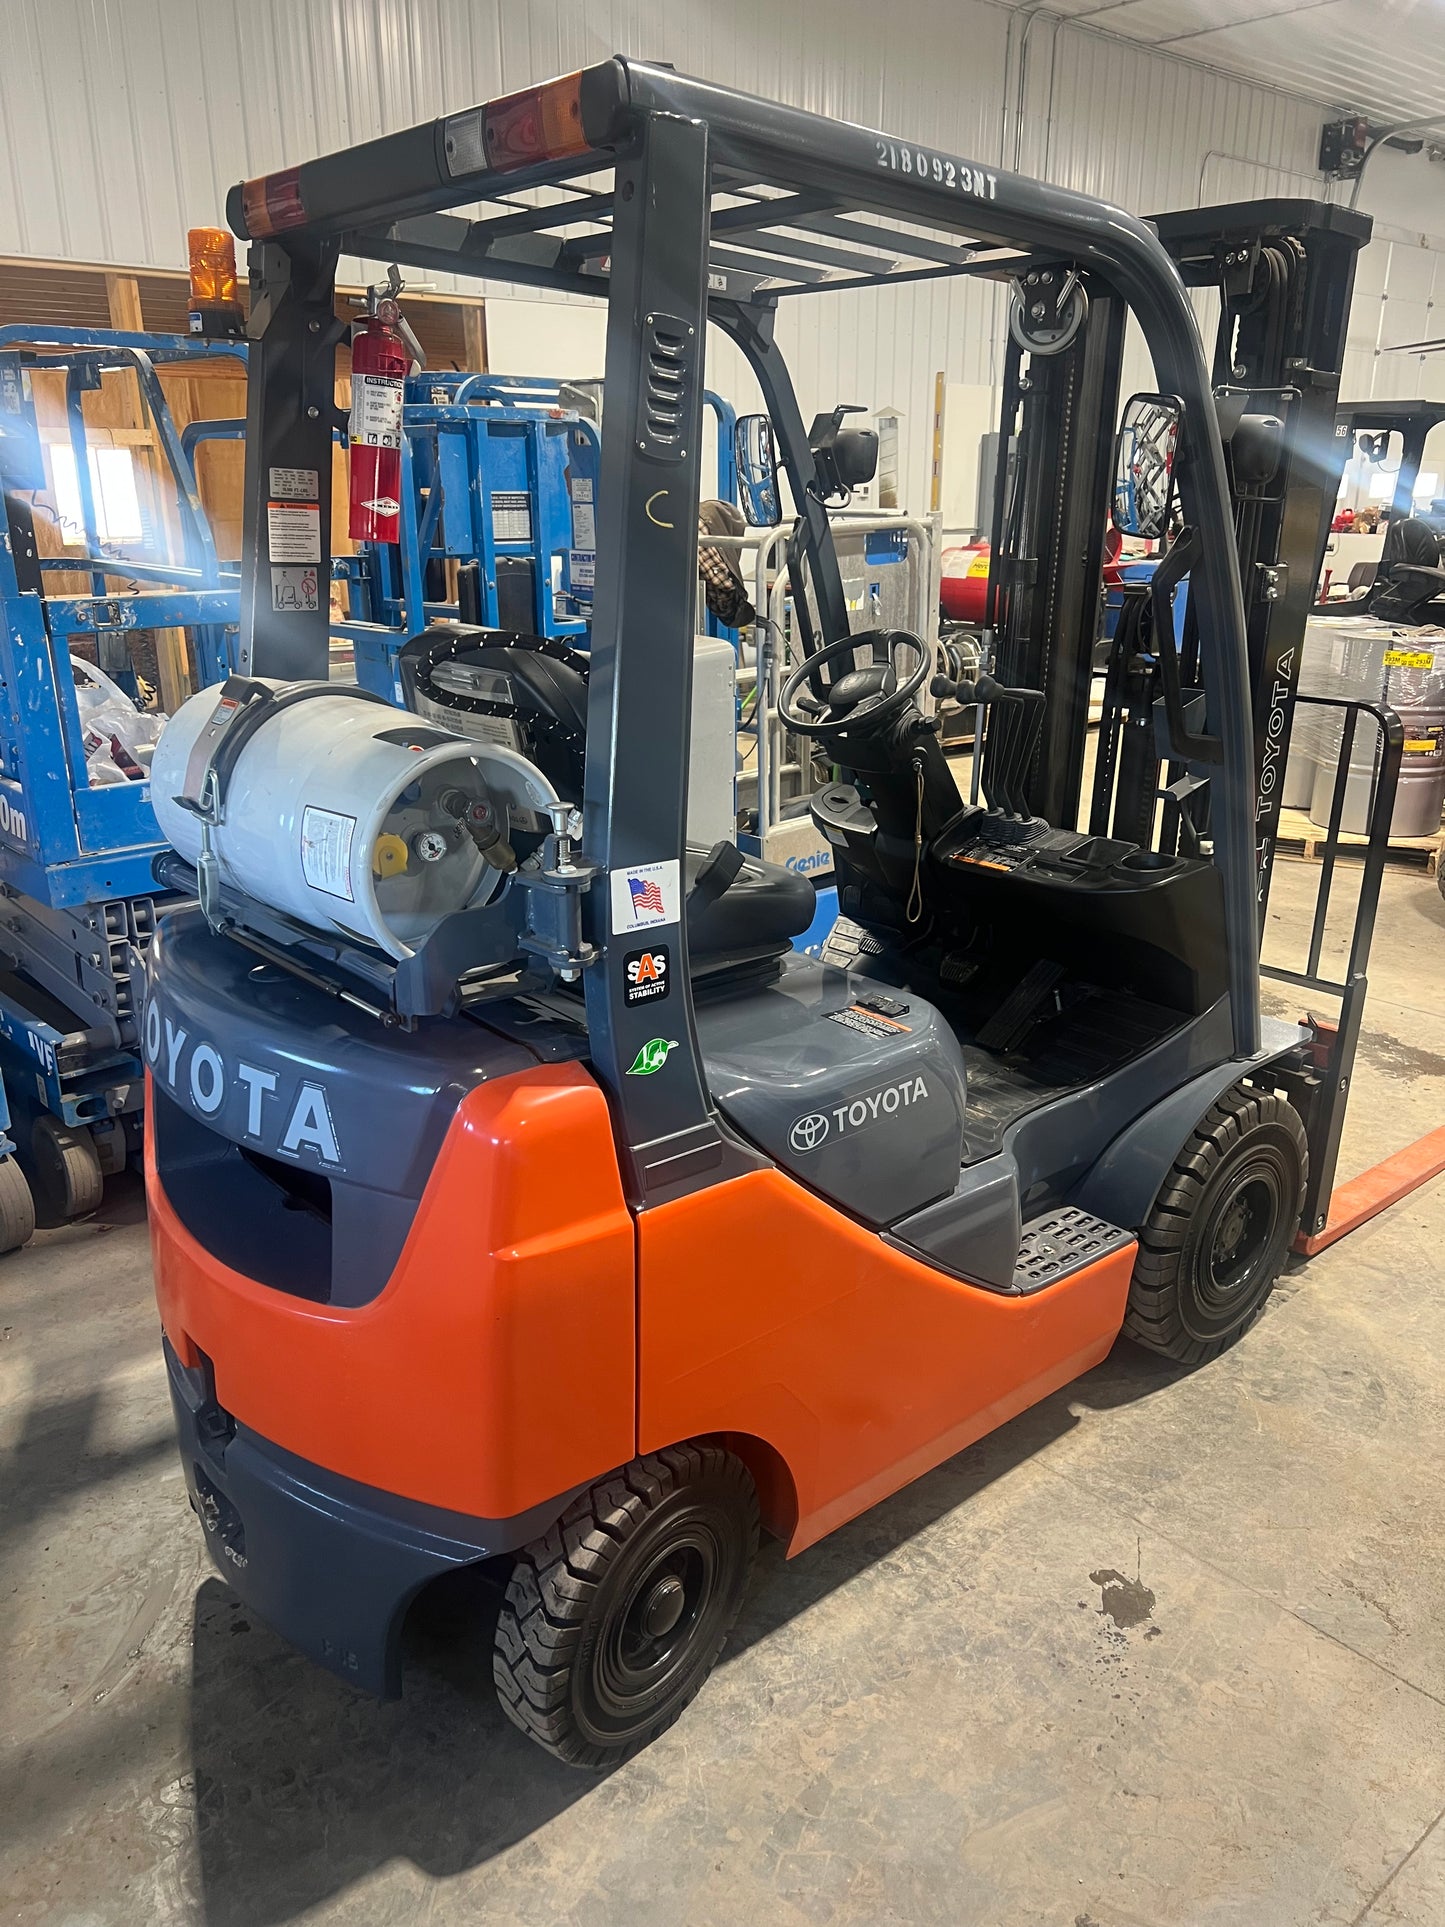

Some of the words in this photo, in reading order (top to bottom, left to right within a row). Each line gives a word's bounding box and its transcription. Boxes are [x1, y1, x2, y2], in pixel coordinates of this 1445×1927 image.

[1256, 646, 1295, 822] TOYOTA
[785, 851, 830, 872] Genie
[627, 953, 666, 984] SAS
[629, 985, 645, 993] SYSTEM
[629, 985, 666, 1000] STABILITY
[832, 1076, 929, 1132] TOYOTA
